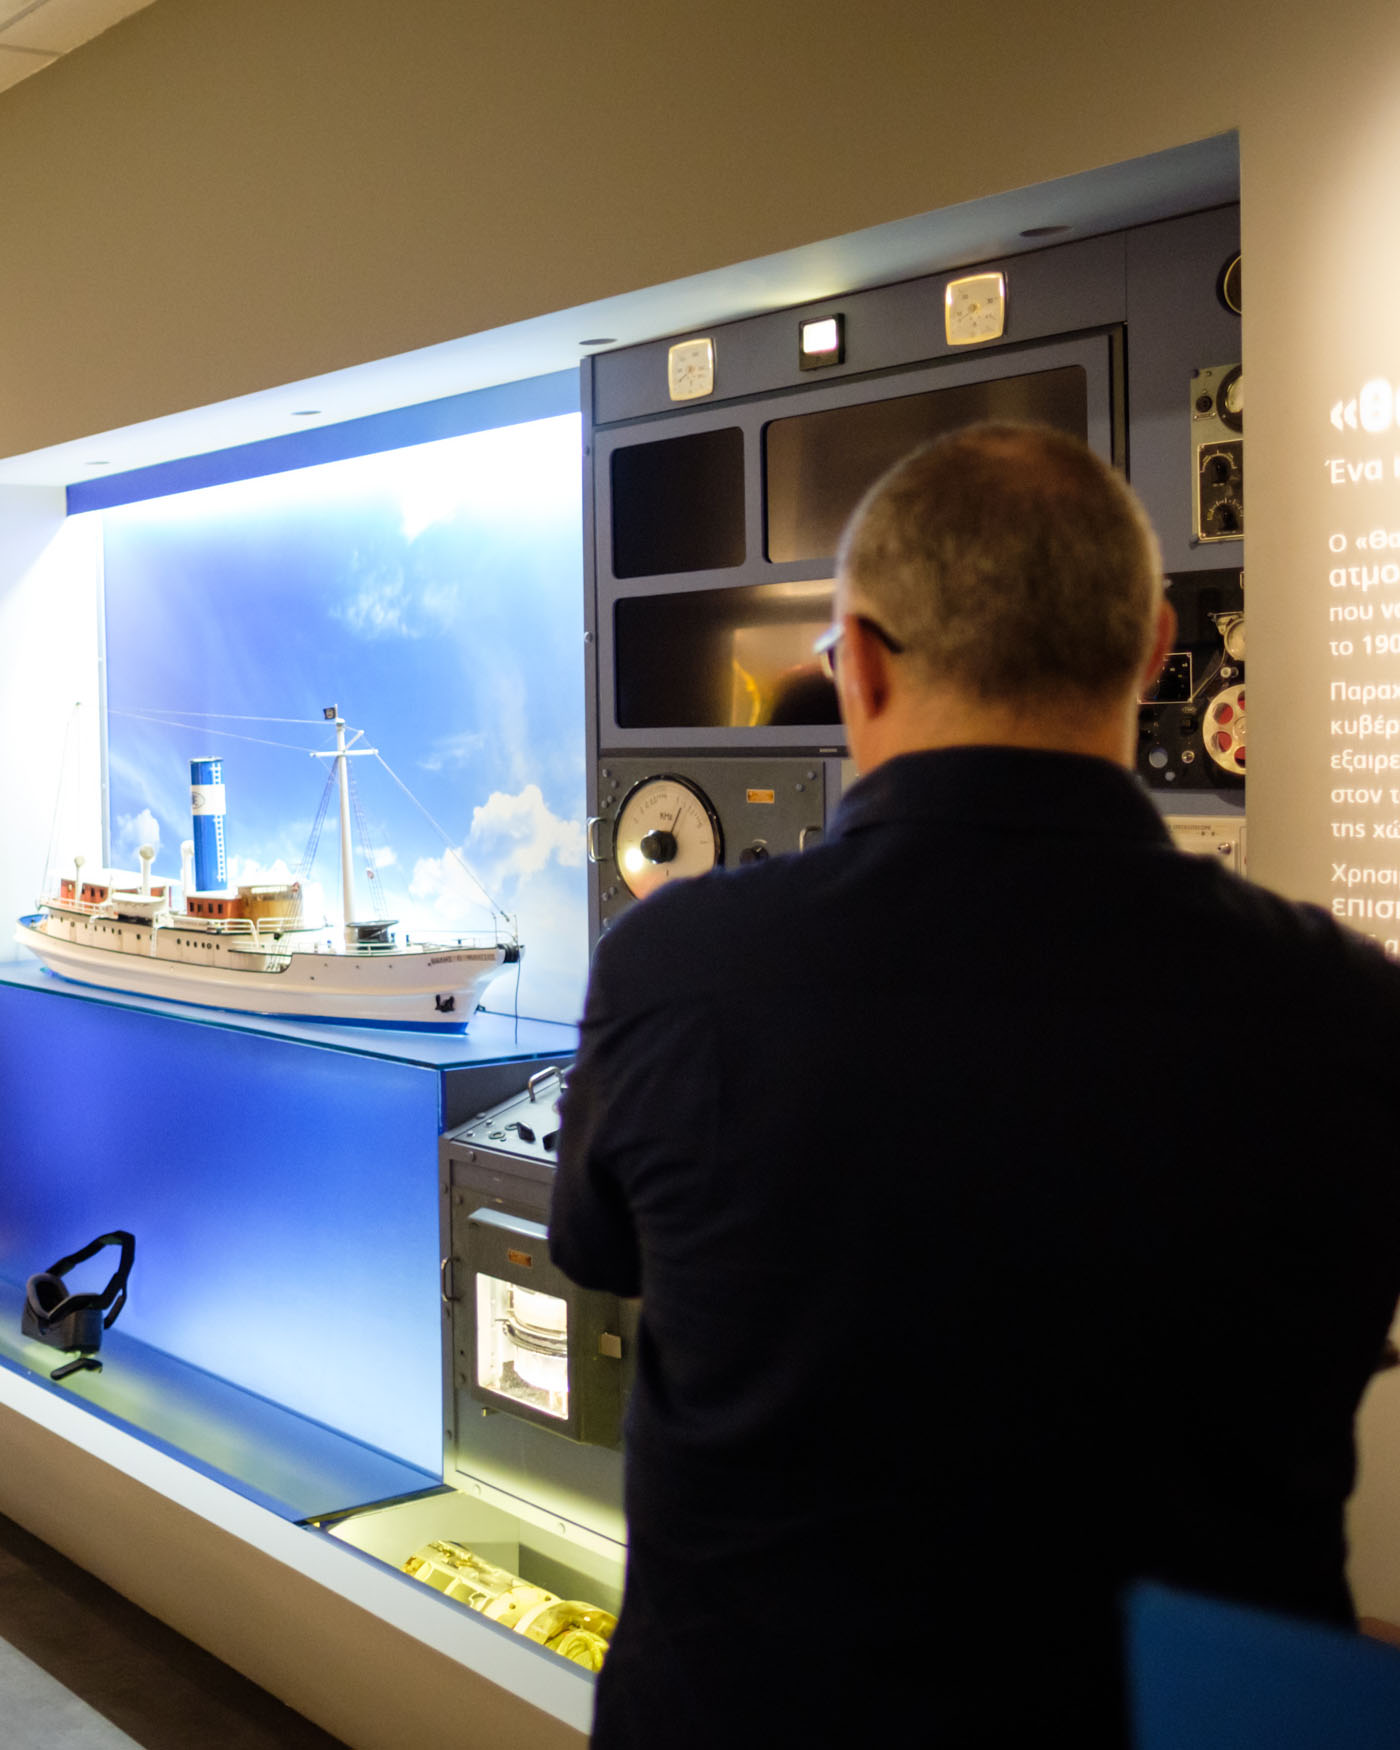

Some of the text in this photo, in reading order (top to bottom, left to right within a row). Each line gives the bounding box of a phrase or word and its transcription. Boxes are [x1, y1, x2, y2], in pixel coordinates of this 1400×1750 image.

[1324, 458, 1384, 484] Ένα
[1329, 534, 1347, 553] Ο
[1330, 604, 1374, 622] που
[1330, 639, 1354, 656] το
[1331, 787, 1383, 805] στον
[1332, 863, 1400, 888] Χρησι
[1332, 898, 1400, 919] επισ
